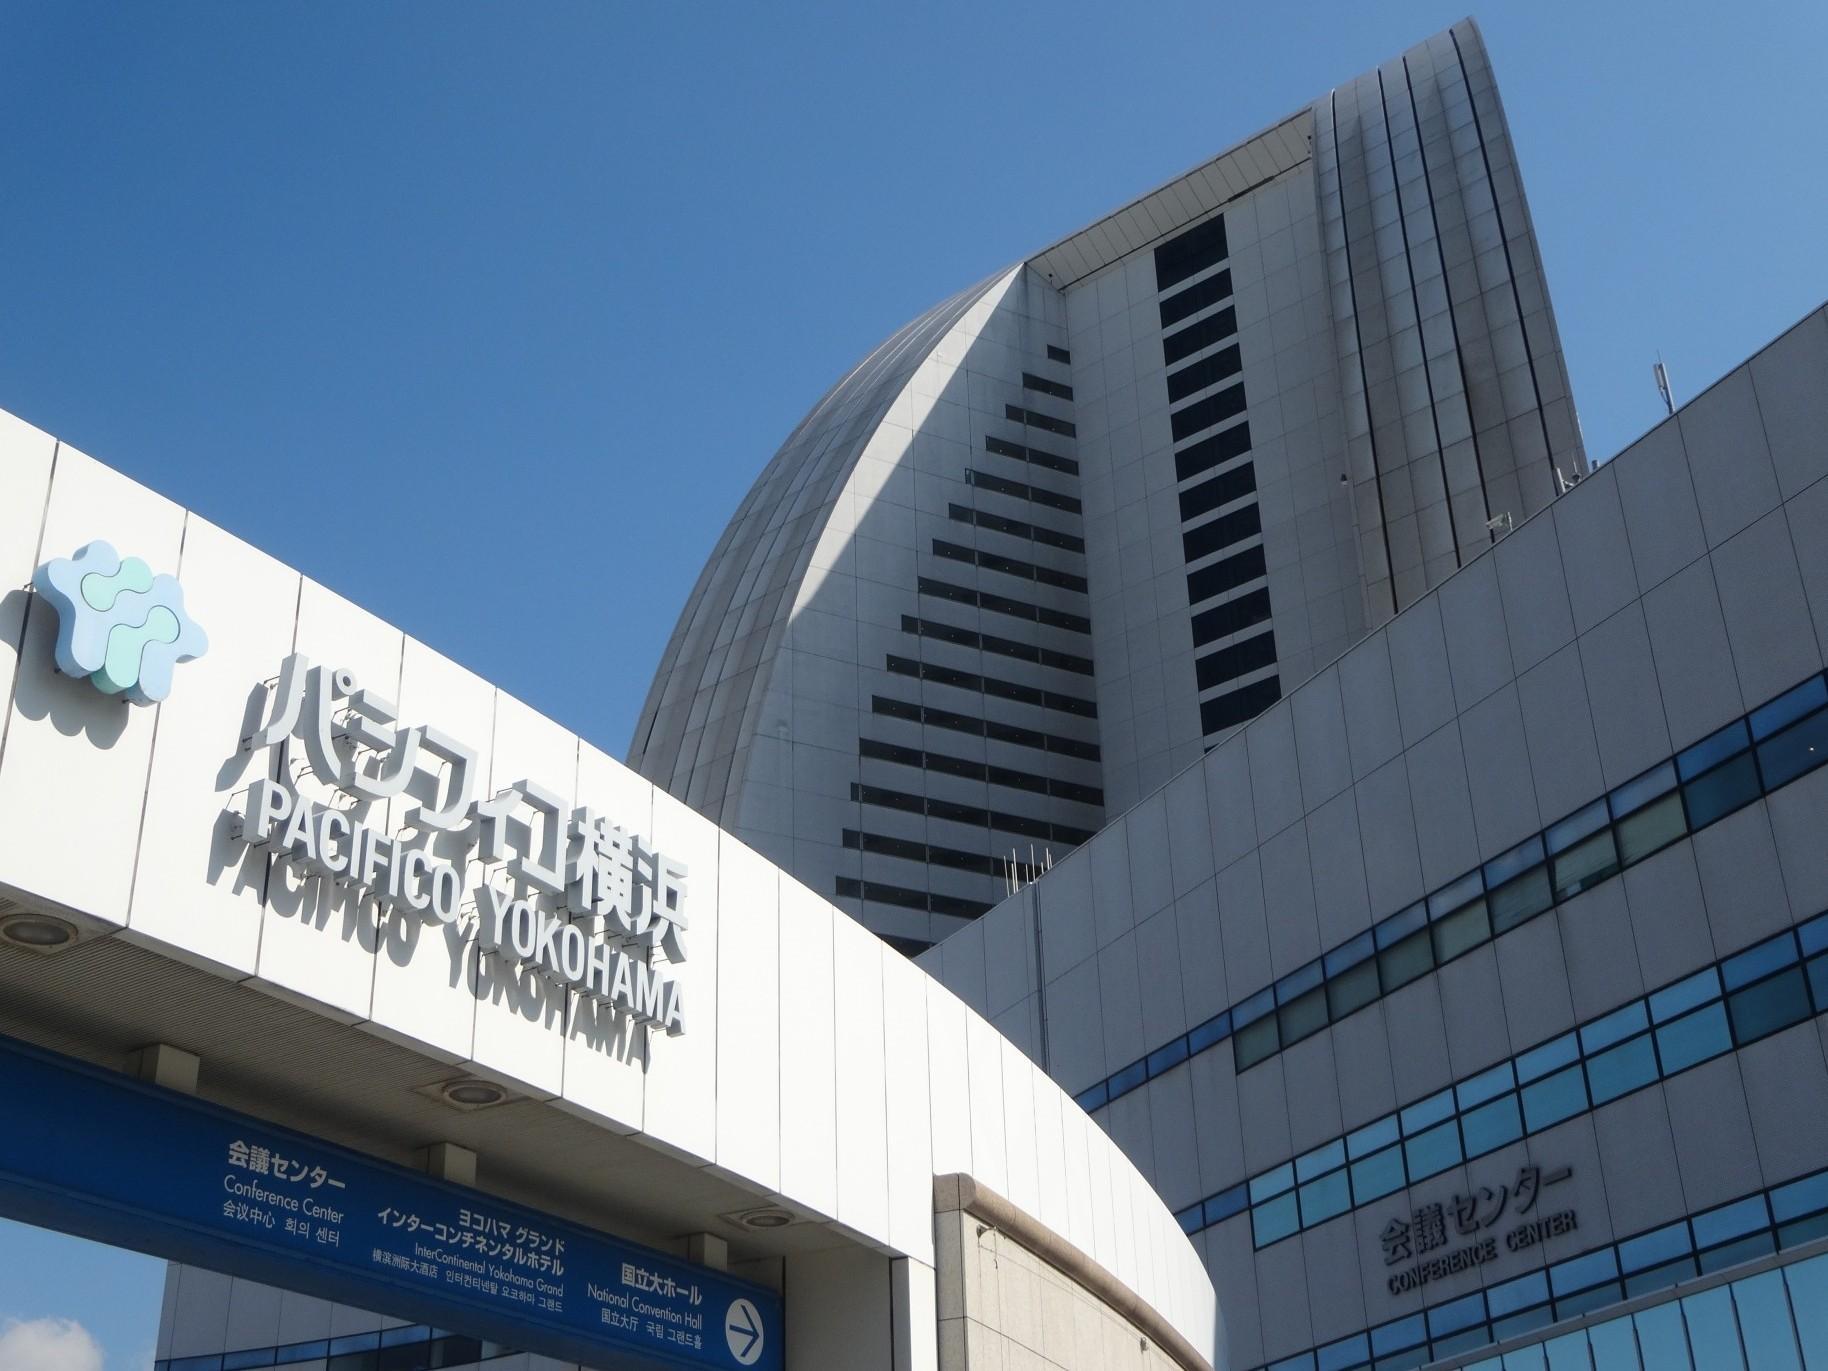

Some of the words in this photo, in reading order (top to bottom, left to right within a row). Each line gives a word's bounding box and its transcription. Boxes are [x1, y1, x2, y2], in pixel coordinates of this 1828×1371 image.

[252, 653, 687, 963] パシフィコ横浜
[243, 778, 460, 926] PACIFICO
[474, 884, 686, 1037] YOKOHAMA
[228, 1140, 346, 1189] 会議センター
[223, 1199, 276, 1229] 会议中心
[224, 1174, 299, 1212] Conference
[303, 1198, 344, 1225] Center
[1379, 1164, 1574, 1266] 会議センター
[284, 1216, 310, 1239] 회의
[316, 1225, 340, 1248] 센터
[377, 1207, 565, 1277] インターコンチネンタルホテル
[459, 1208, 512, 1239] ヨコハマ
[515, 1226, 565, 1256] グランド
[1387, 1239, 1498, 1296] CONFERENCE
[1506, 1209, 1578, 1253] CENTER
[373, 1247, 439, 1279] 横滨洲际大酒店
[415, 1242, 486, 1275] InterContinental
[488, 1263, 534, 1289] Yokohama
[536, 1278, 564, 1298] Grand
[621, 1262, 703, 1306] 国立大ホール
[501, 1285, 535, 1305] 요코하마
[587, 1282, 629, 1309] National
[631, 1297, 682, 1323] Convention
[684, 1312, 702, 1331] Hall
[601, 1308, 639, 1332] 国立大厅
[646, 1321, 664, 1339] 국립
